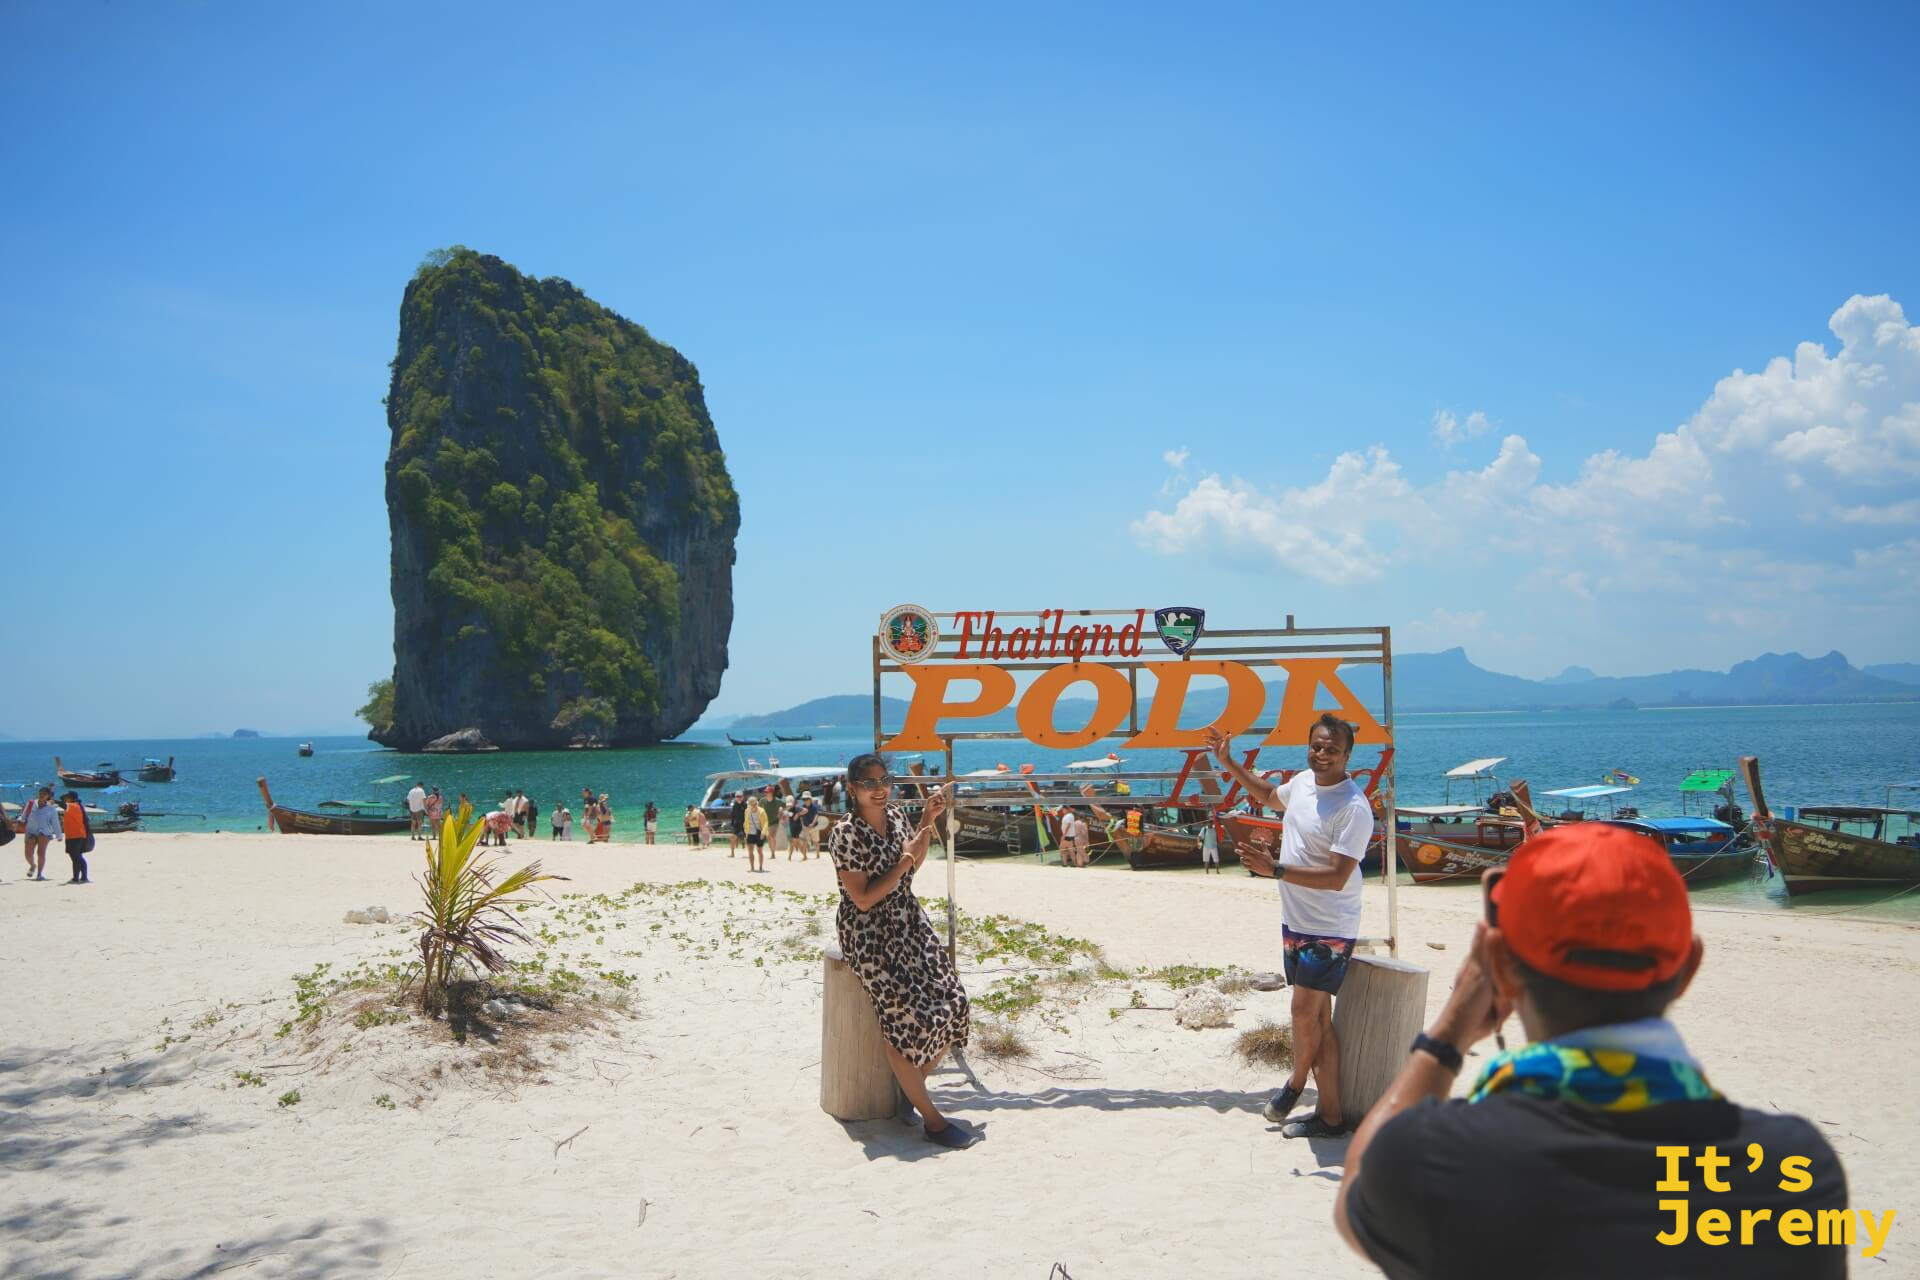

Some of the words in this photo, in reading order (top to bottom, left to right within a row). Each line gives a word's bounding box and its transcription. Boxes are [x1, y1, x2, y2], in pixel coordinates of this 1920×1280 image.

[953, 608, 1146, 660] Thailand
[878, 658, 1393, 751] PODA
[1153, 747, 1395, 812] Ilad
